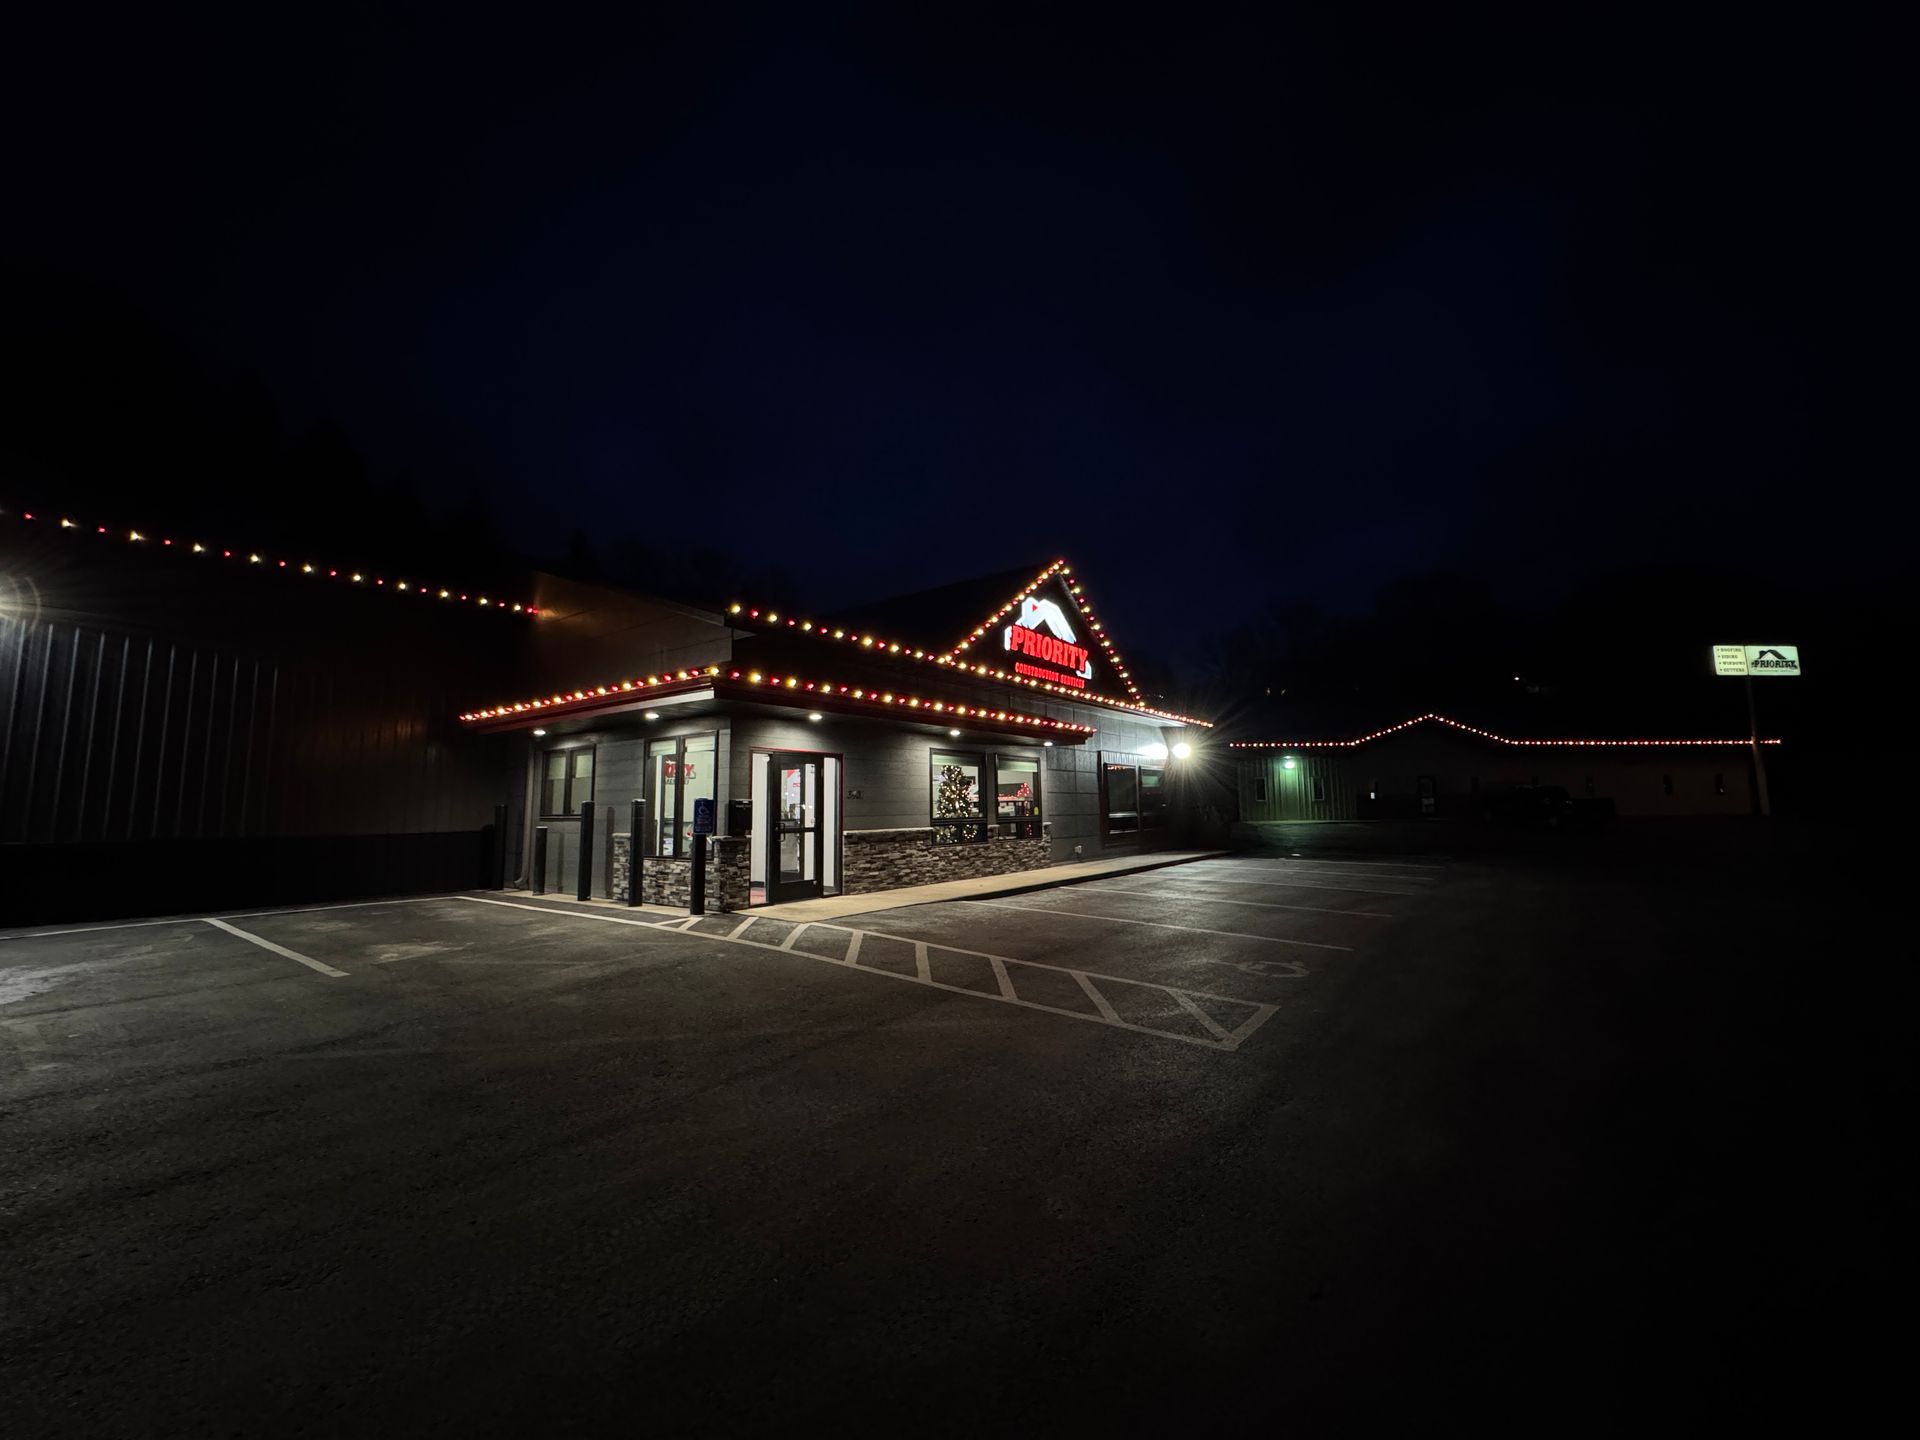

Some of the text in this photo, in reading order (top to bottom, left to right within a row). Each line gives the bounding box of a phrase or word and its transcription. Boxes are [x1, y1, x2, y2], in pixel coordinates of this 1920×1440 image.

[1011, 625, 1088, 671] PRIORITY
[1015, 662, 1085, 689] CONSTRUCTION SERVICES
[1754, 660, 1796, 668] PRIORITY
